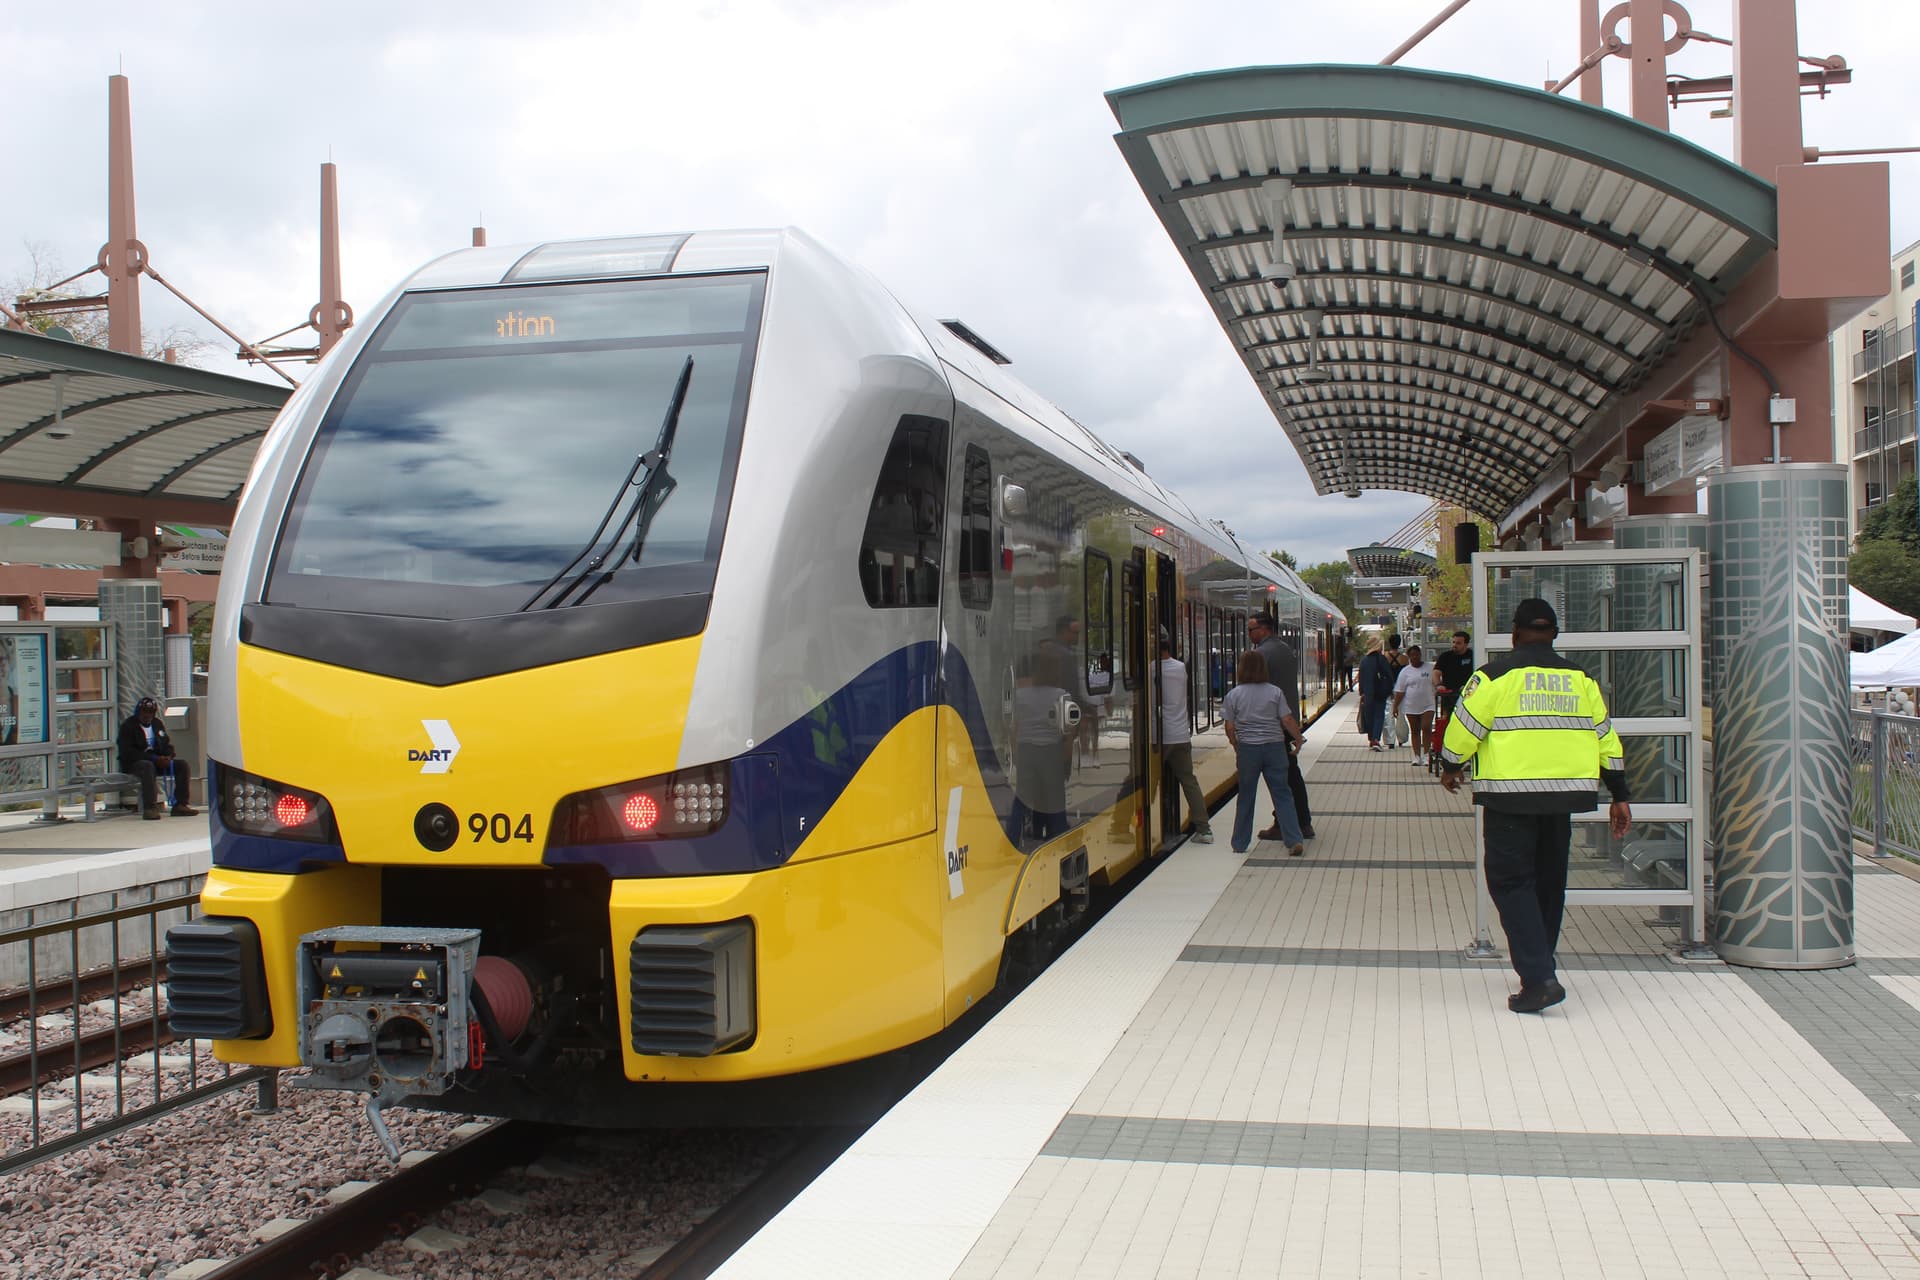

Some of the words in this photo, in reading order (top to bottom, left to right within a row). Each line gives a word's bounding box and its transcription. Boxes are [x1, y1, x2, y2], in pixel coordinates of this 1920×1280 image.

[181, 551, 201, 561] Before
[1525, 672, 1573, 692] FARE
[1519, 694, 1580, 712] ENFORCEMENT
[408, 749, 452, 761] DART
[468, 812, 534, 844] 904
[799, 816, 806, 831] F
[948, 844, 969, 876] DART
